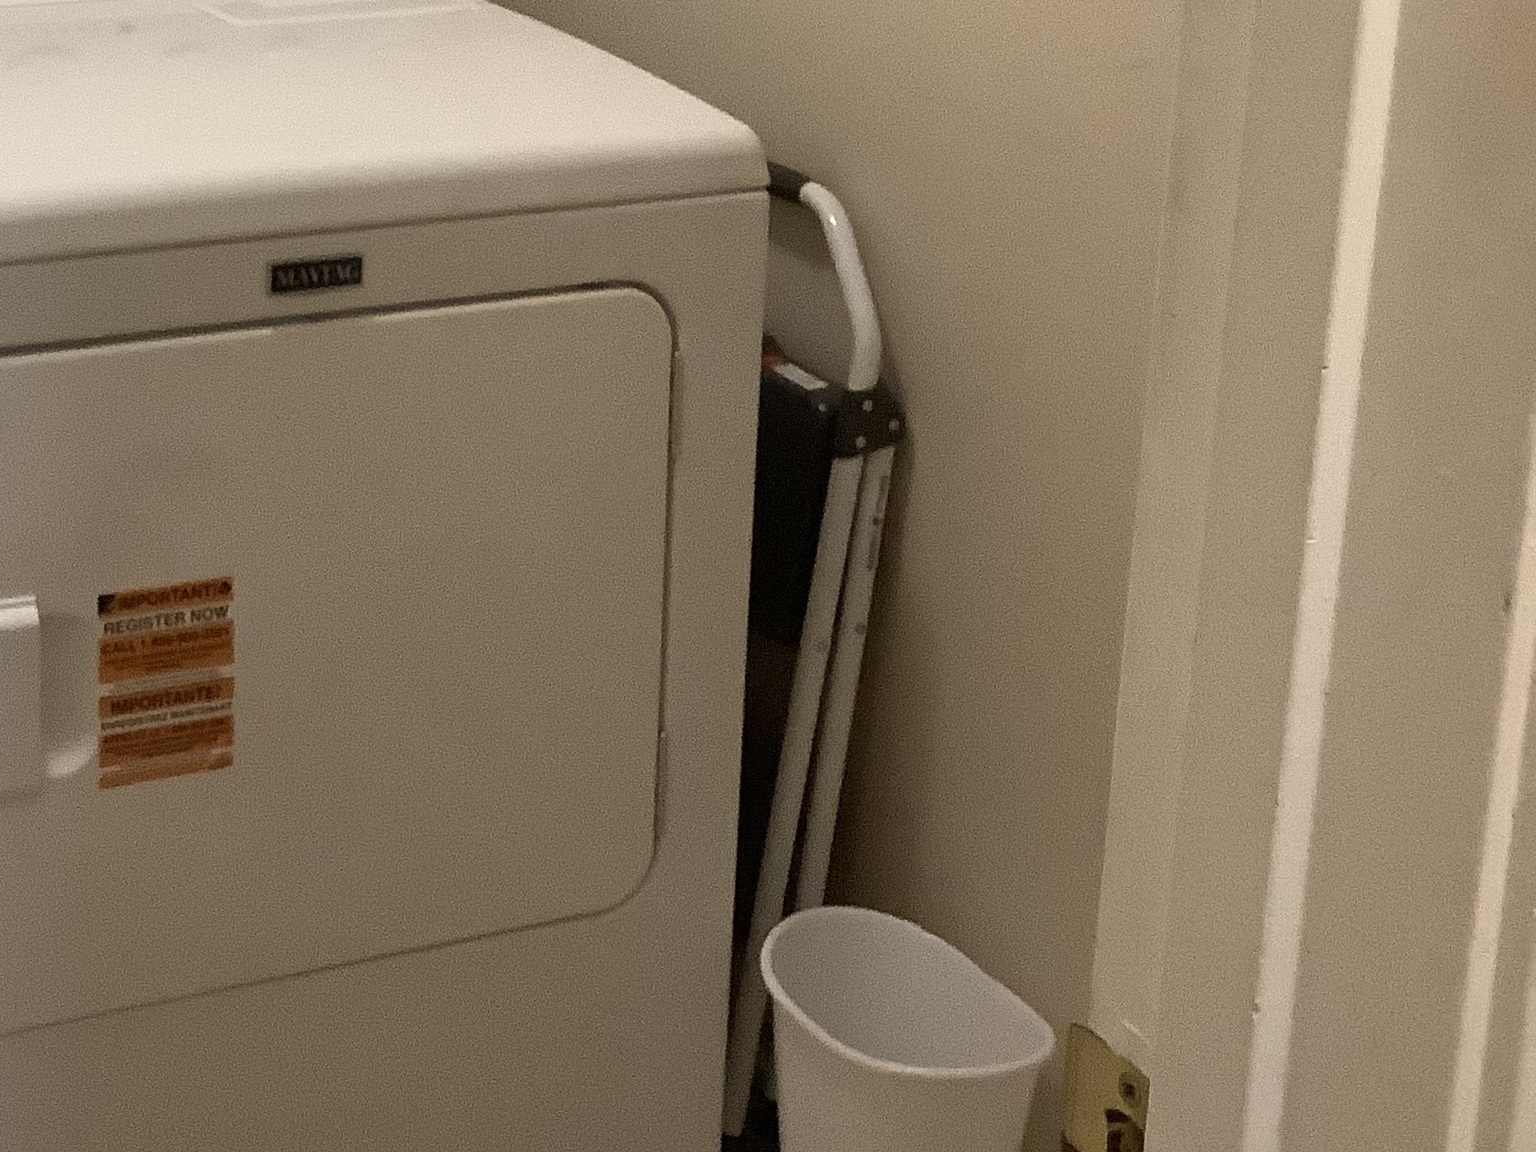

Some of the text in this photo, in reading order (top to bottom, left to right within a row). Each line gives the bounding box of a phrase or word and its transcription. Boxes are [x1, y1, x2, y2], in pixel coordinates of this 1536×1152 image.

[275, 263, 360, 286] MAYTAG
[104, 606, 230, 634] REGISTER NOW
